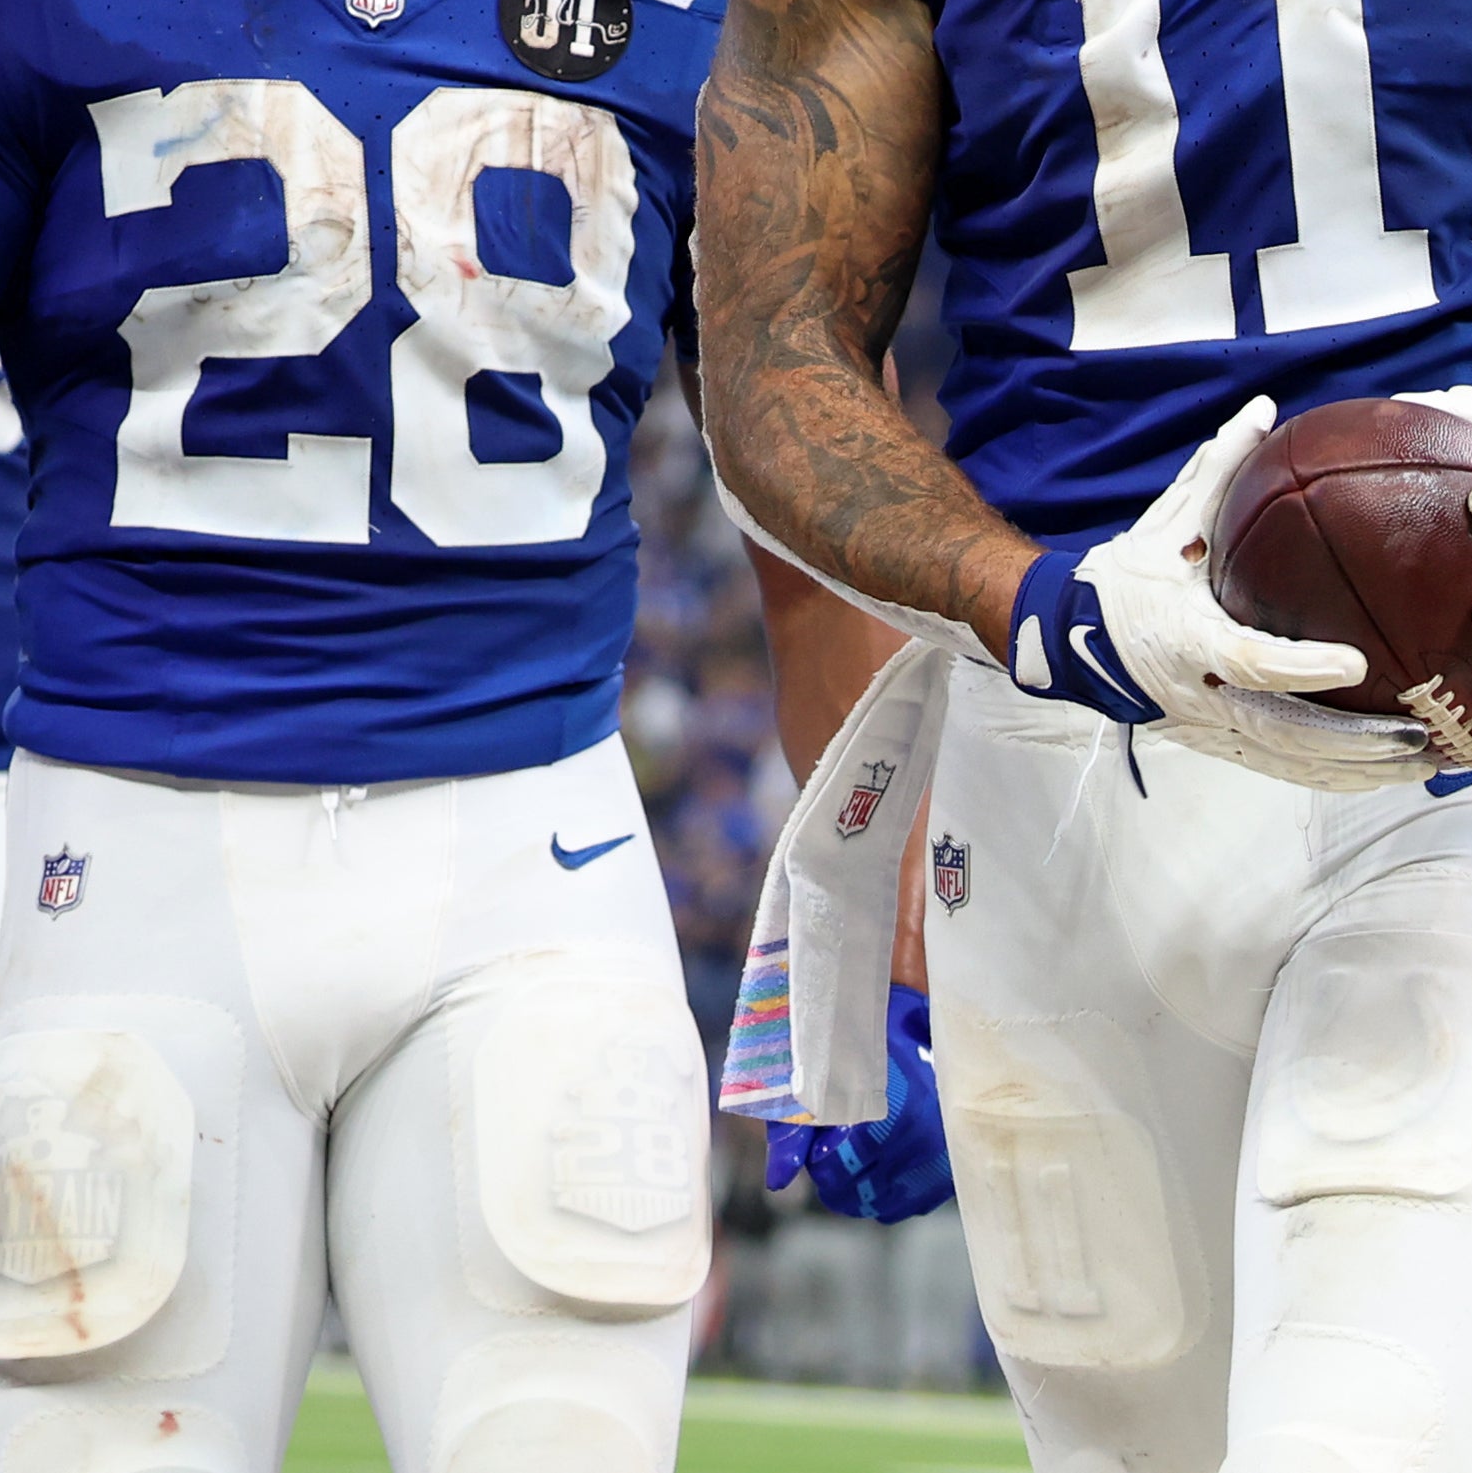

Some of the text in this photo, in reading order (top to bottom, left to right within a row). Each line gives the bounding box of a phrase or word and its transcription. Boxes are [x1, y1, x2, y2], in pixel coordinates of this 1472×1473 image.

[87, 79, 638, 546] 28
[41, 876, 78, 902] NFL
[935, 867, 963, 899] NFL
[550, 1120, 690, 1187] 28
